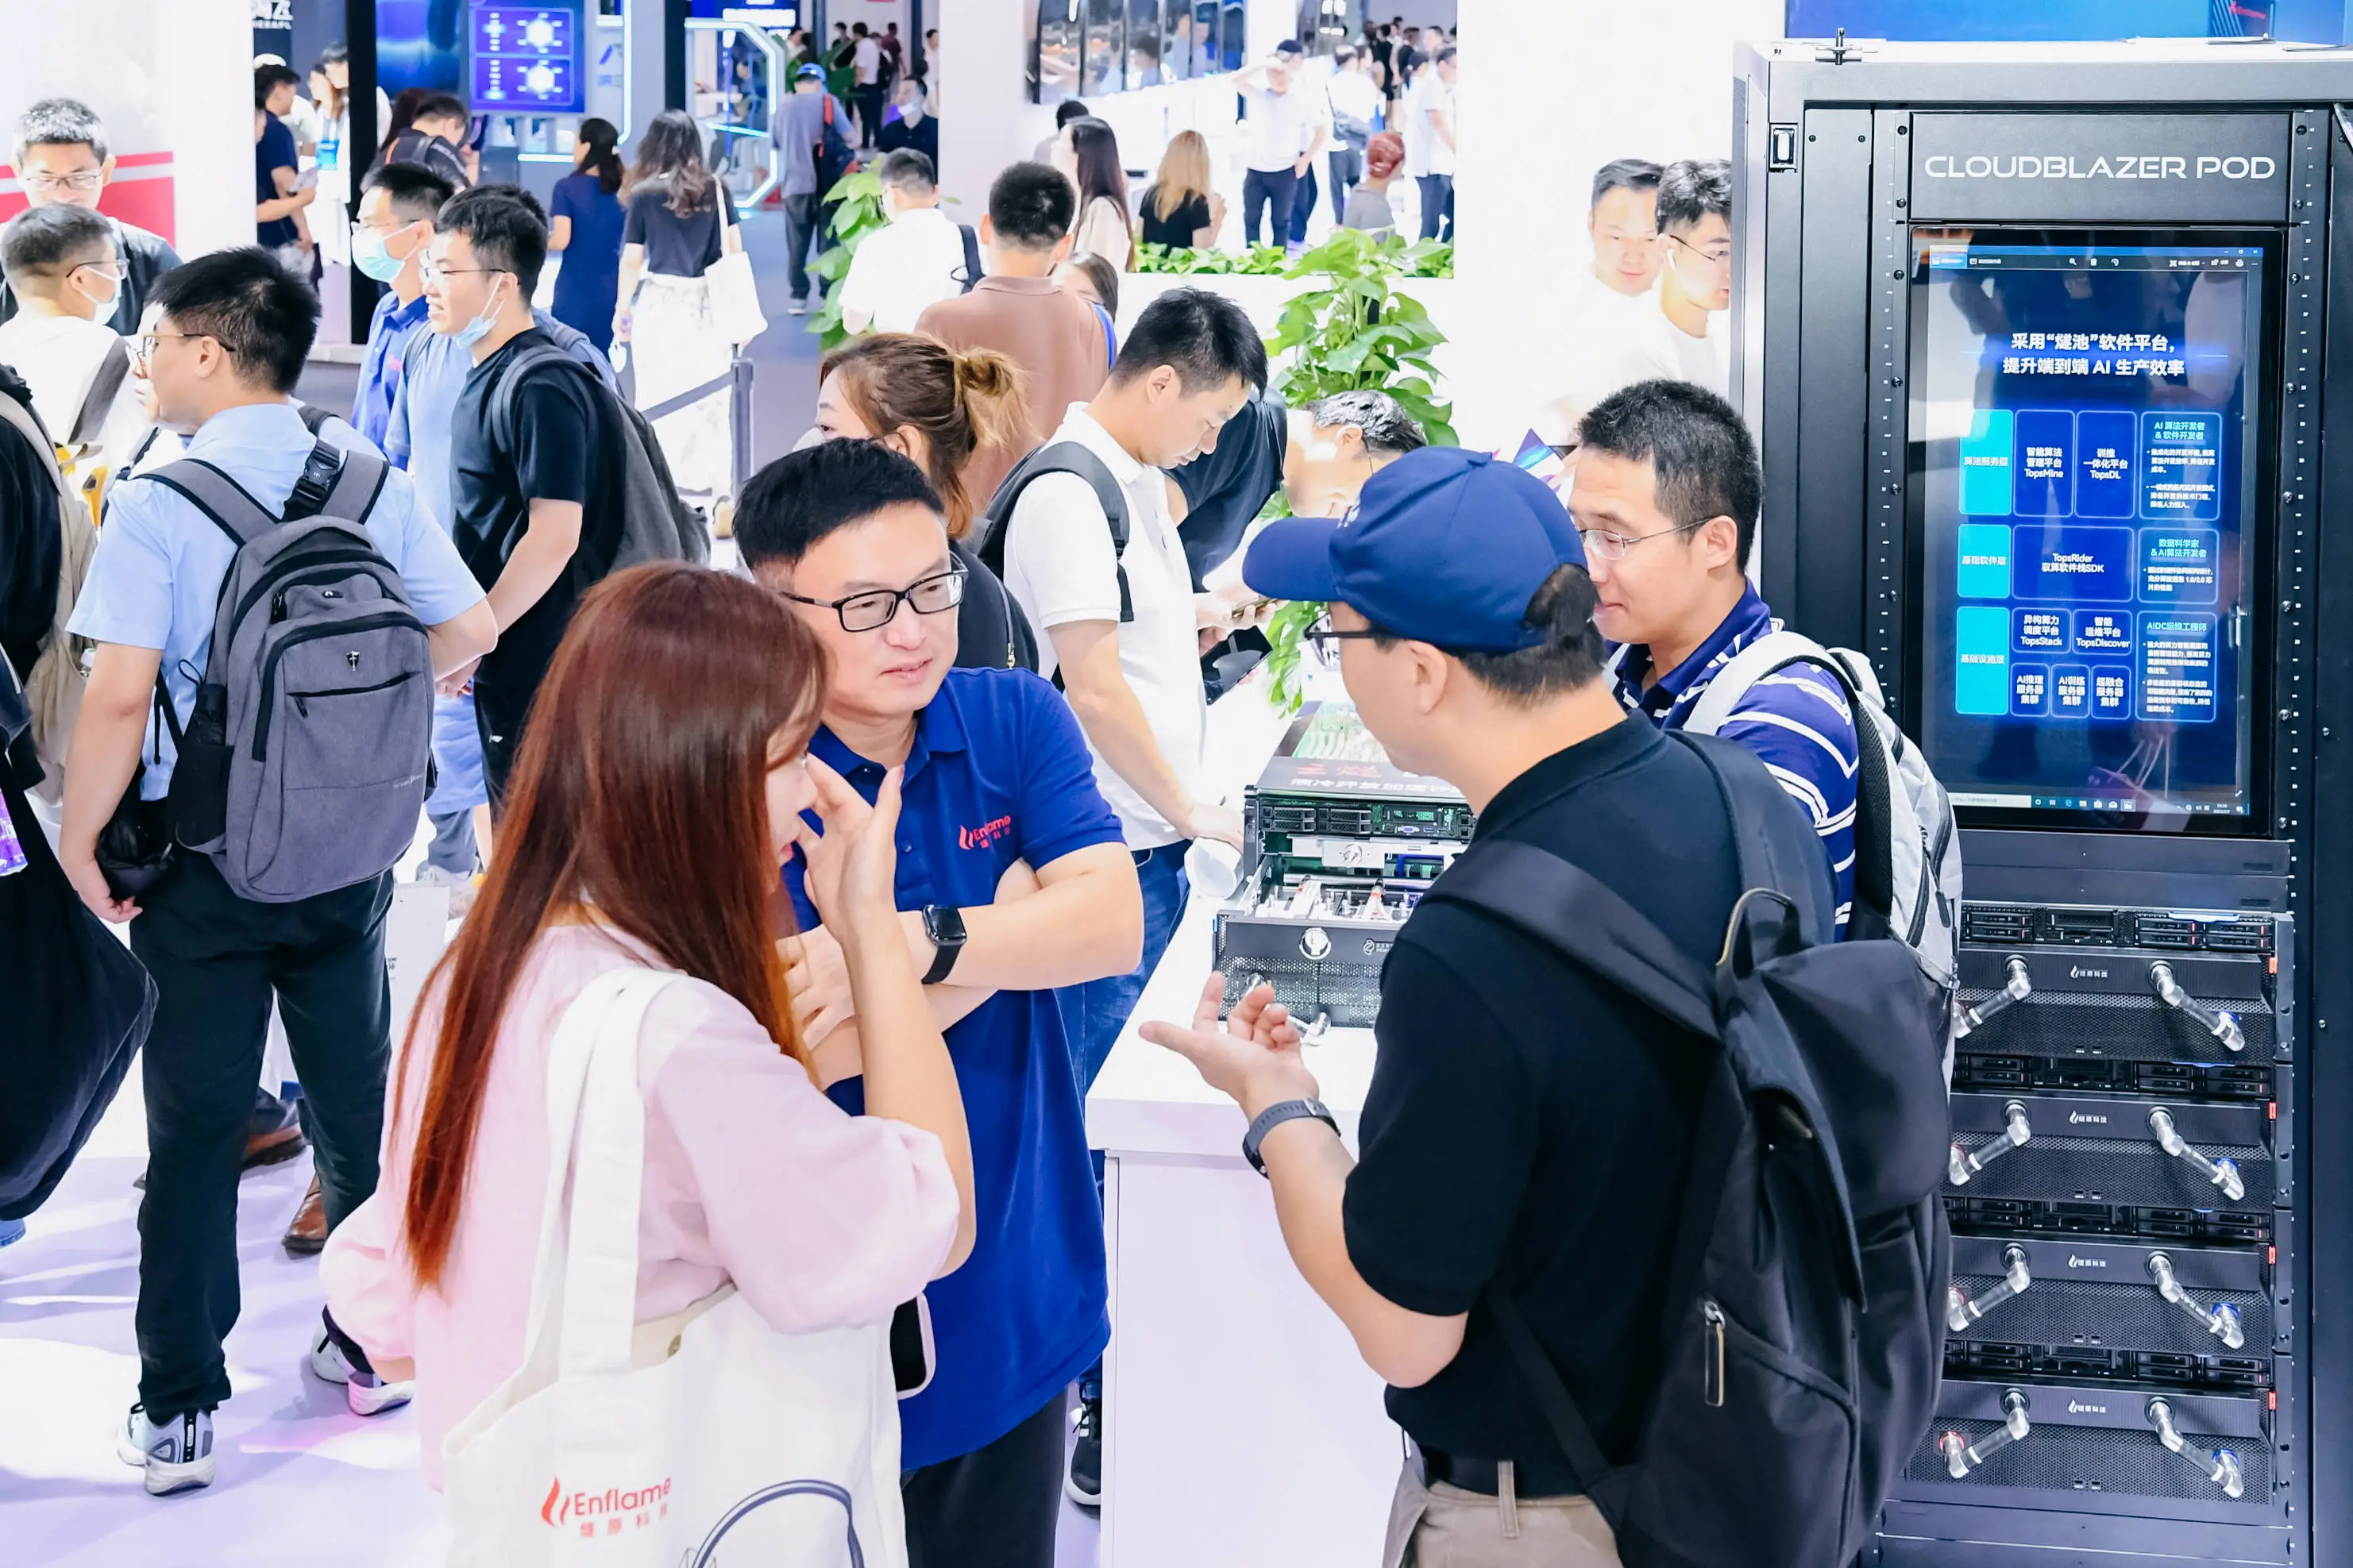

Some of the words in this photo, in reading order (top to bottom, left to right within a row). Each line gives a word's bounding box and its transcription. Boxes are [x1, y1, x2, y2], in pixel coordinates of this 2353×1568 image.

[1924, 156, 2187, 179] CLOUDBLAZER
[2196, 156, 2276, 179] POD
[2003, 356, 2089, 376] 提升端到端
[2092, 359, 2111, 375] AI
[2115, 359, 2185, 377] 生产效率
[2083, 458, 2129, 469] 一体化平台
[2075, 637, 2131, 649] TopsDiscover
[574, 1477, 672, 1516] Enflame
